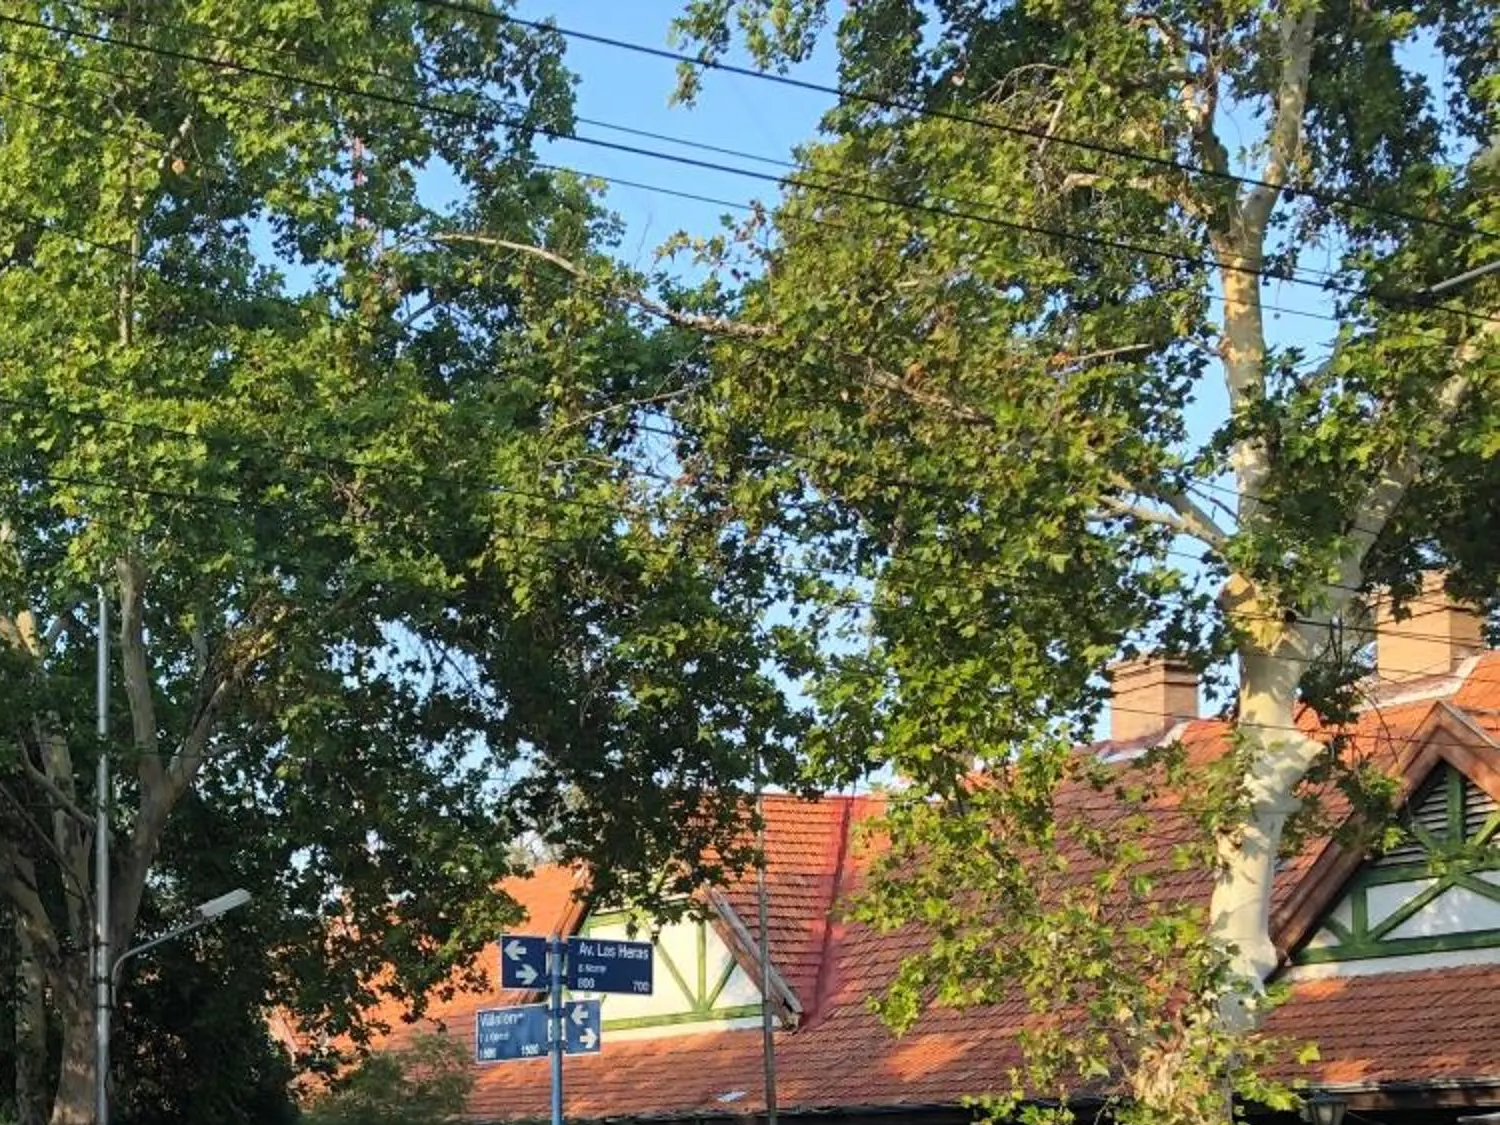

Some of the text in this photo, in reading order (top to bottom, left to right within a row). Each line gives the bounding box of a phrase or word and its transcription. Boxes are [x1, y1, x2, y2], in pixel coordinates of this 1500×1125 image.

[579, 942, 595, 957] Av.
[618, 945, 650, 960] Heras
[632, 980, 650, 992] 700
